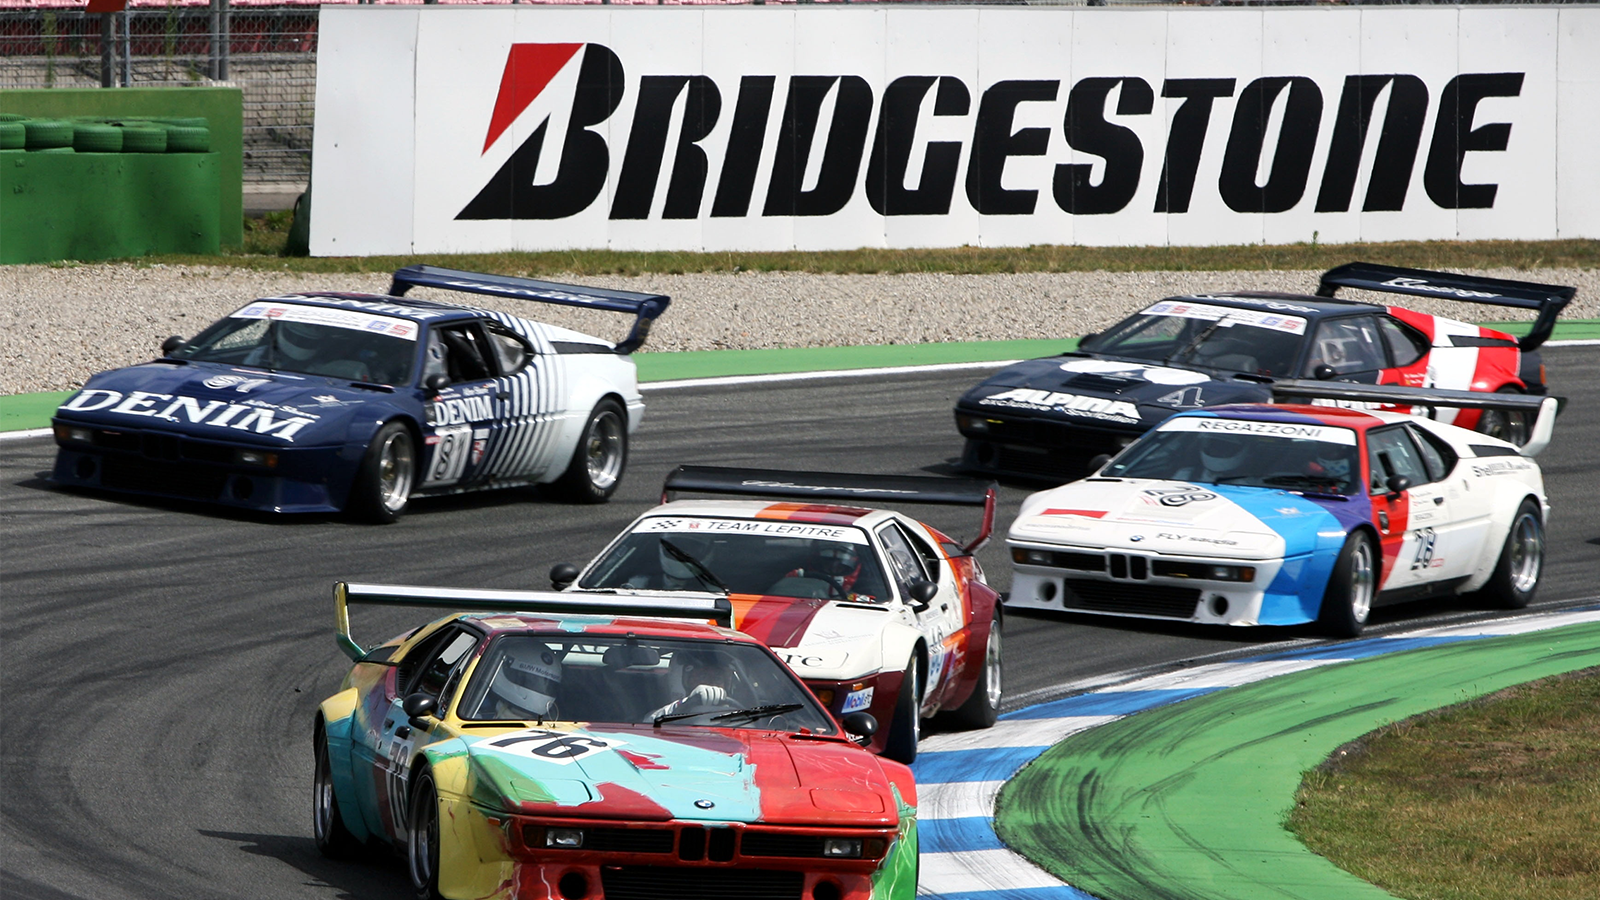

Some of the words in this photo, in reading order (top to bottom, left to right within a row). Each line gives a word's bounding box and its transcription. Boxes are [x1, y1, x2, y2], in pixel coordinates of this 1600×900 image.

[455, 42, 1524, 220] BRIDGESTONE
[58, 389, 316, 443] DENIM
[433, 395, 495, 426] DENIM
[986, 388, 1142, 420] ALPINA
[1197, 420, 1323, 437] REGAZZONI
[707, 521, 760, 531] TEAM
[765, 524, 846, 538] LEPITRE
[1156, 532, 1187, 541] FLY
[1410, 526, 1438, 571] 28
[489, 729, 608, 759] 76
